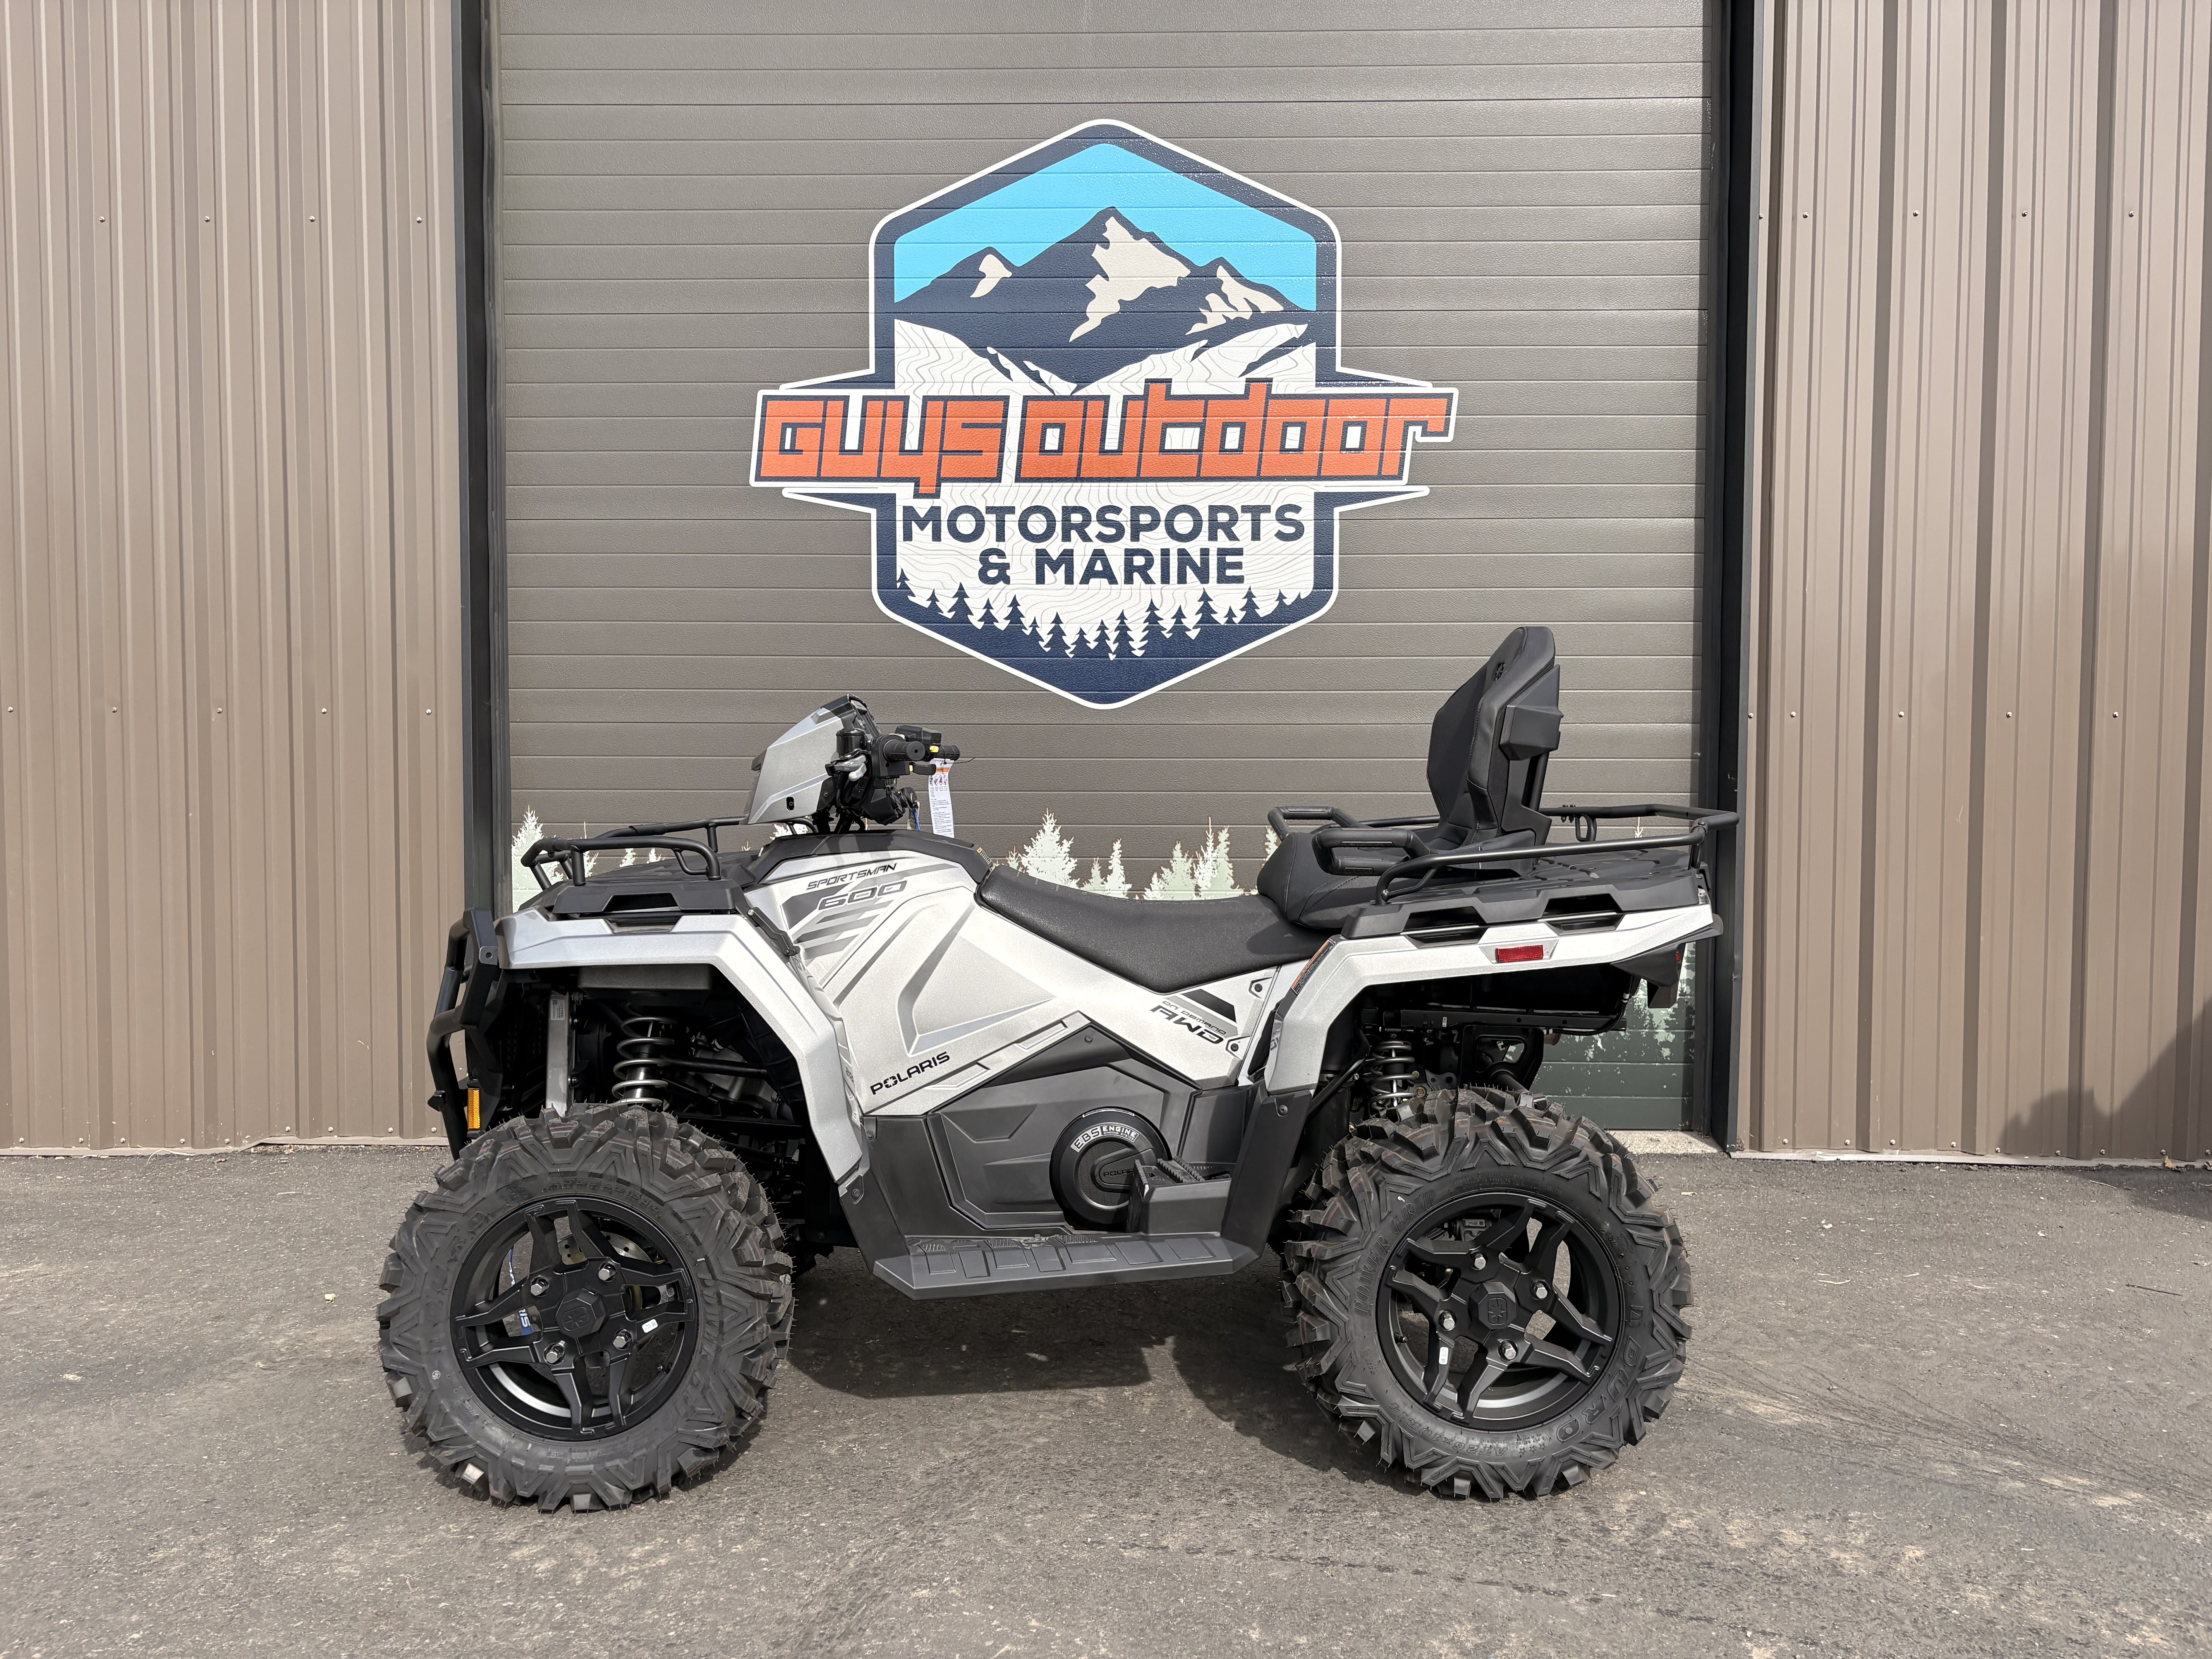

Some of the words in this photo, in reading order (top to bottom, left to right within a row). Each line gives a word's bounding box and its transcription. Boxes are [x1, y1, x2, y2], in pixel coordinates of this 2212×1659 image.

[902, 503, 1305, 543] MOTORSPORTS
[977, 547, 1011, 585] &
[1035, 547, 1245, 585] MARINE
[806, 863, 897, 890] SPORTSMAN
[818, 879, 907, 910] 600
[1149, 1005, 1224, 1044] AWD
[1162, 1001, 1178, 1010] ON
[1180, 1010, 1226, 1035] DEMAND
[870, 1051, 950, 1095] POLARIS
[1073, 1128, 1100, 1149] EBS
[1102, 1126, 1137, 1138] ENGINE
[1103, 1168, 1133, 1177] POLAR
[1355, 1236, 1389, 1318] POWER
[1557, 1336, 1642, 1443] DURO
